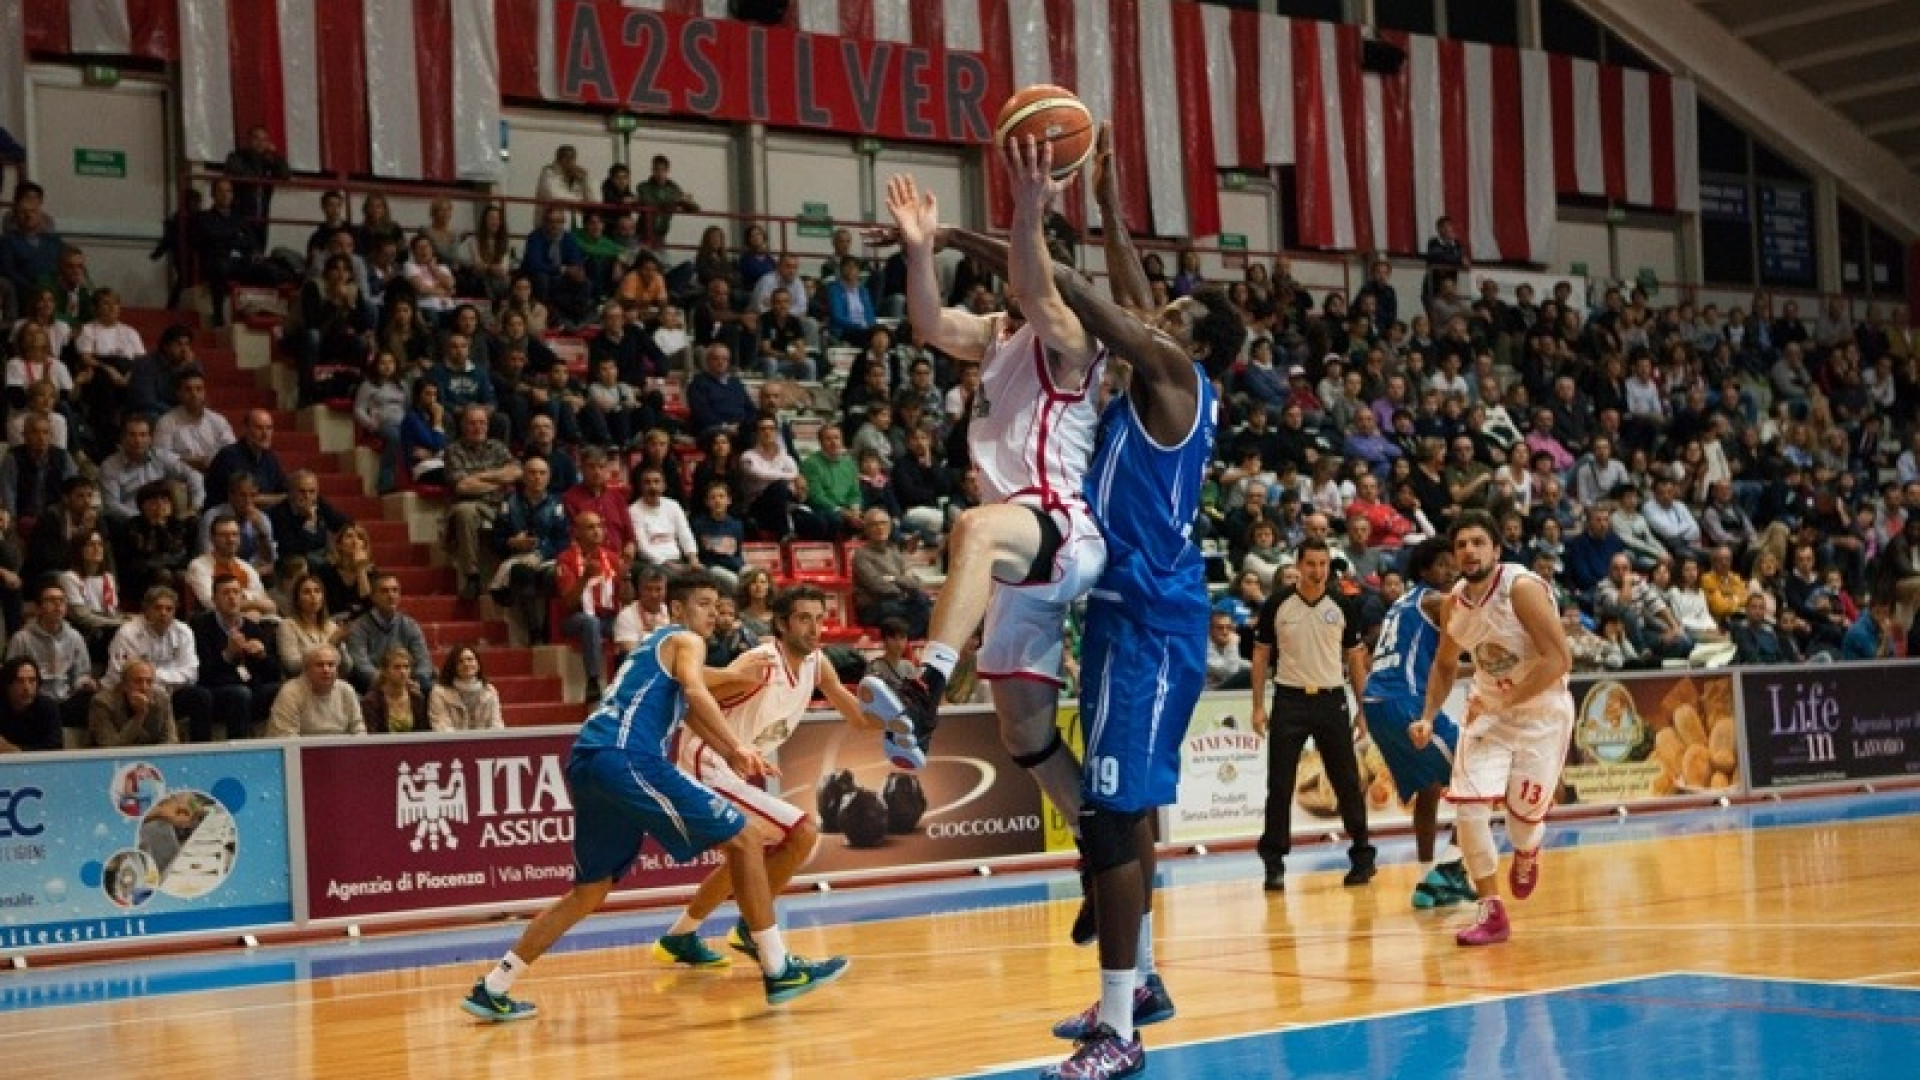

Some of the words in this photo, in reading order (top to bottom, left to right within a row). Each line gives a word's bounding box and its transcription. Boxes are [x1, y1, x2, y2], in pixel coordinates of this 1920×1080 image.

[1767, 682, 1840, 736] Life
[475, 755, 575, 817] ITA
[1090, 756, 1120, 796] 19
[1519, 779, 1542, 805] 13
[480, 815, 575, 849] ASSICU
[926, 814, 1040, 838] CIOCCOLATO
[638, 853, 662, 870] Tel.
[327, 876, 392, 902] Agenzia
[396, 871, 413, 891] di
[416, 868, 486, 890] Piacenza
[498, 866, 522, 883] Via
[0, 917, 146, 947] itecsrl.it
